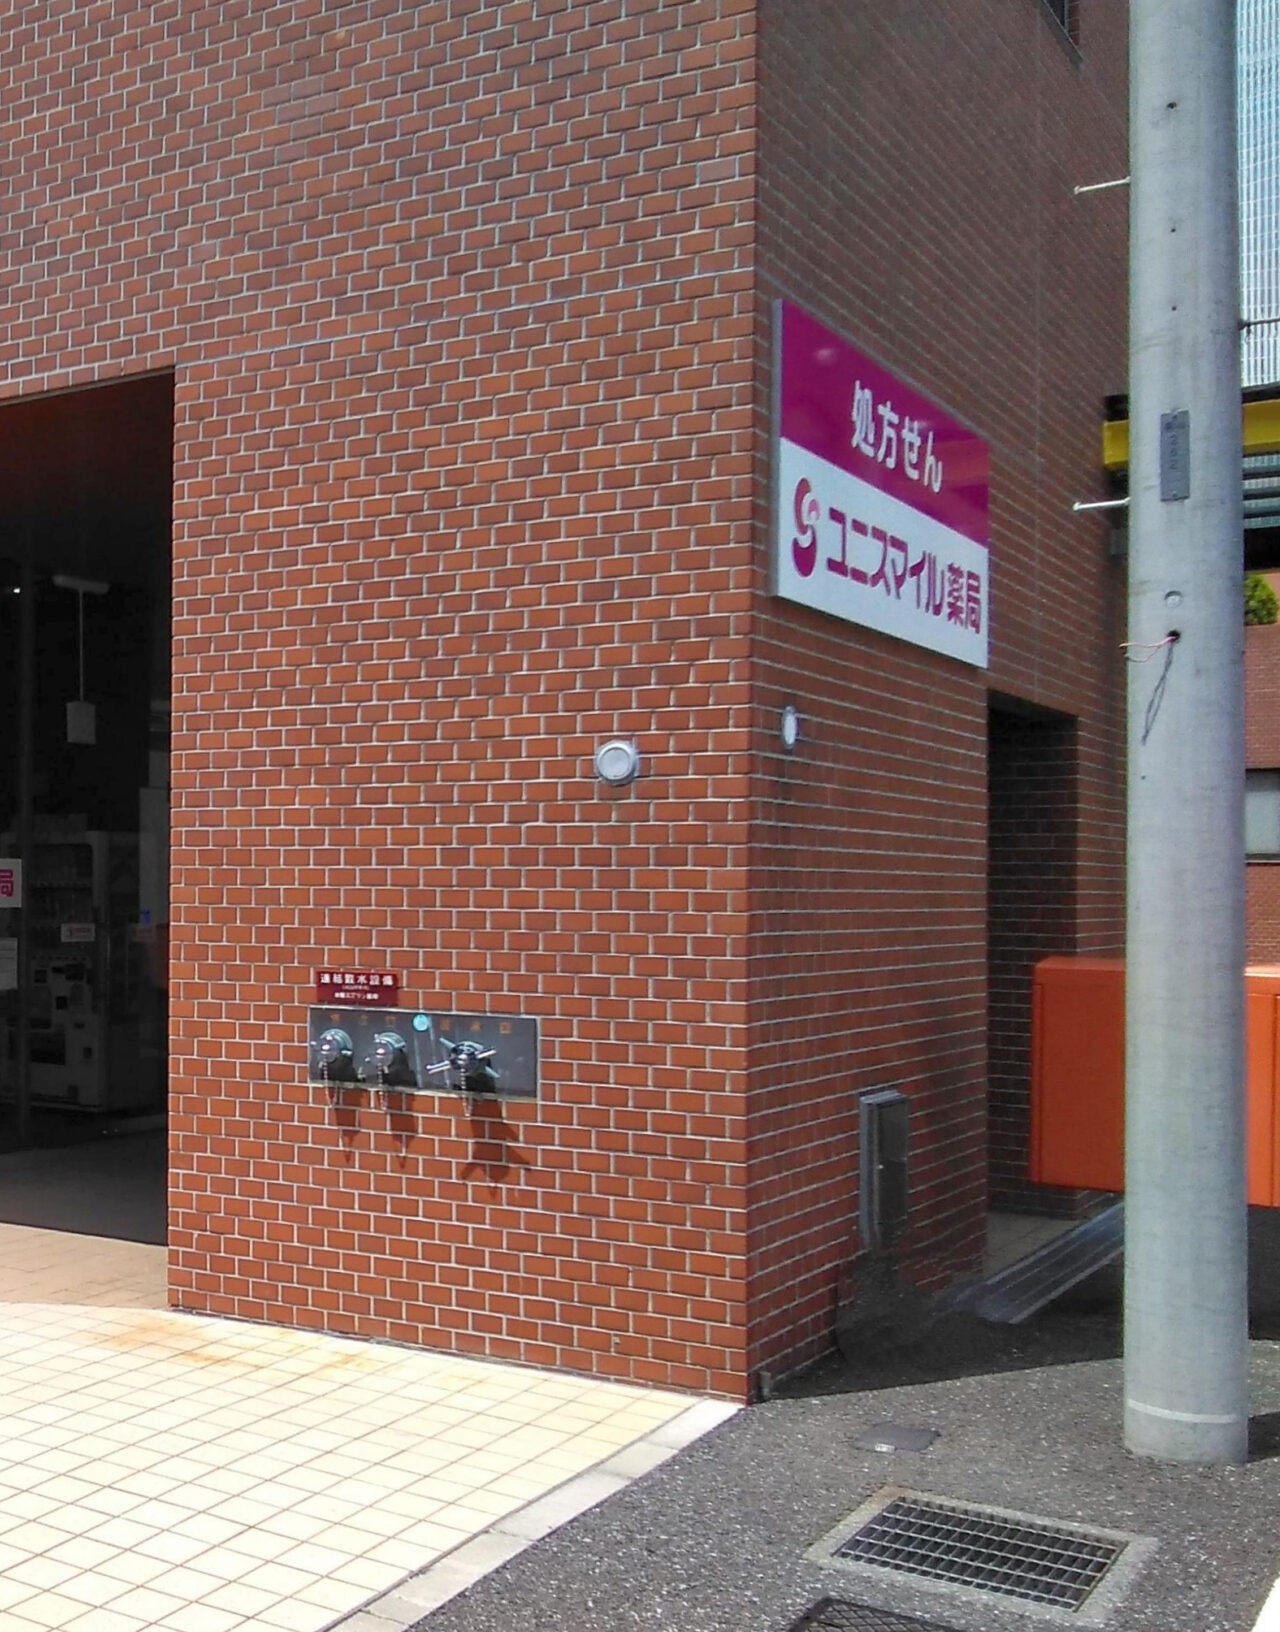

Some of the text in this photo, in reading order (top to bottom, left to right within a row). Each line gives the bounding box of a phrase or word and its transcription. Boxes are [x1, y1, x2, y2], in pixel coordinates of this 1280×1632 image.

[851, 380, 943, 494] 処方せん
[825, 506, 982, 635] ユニスマイル薬局
